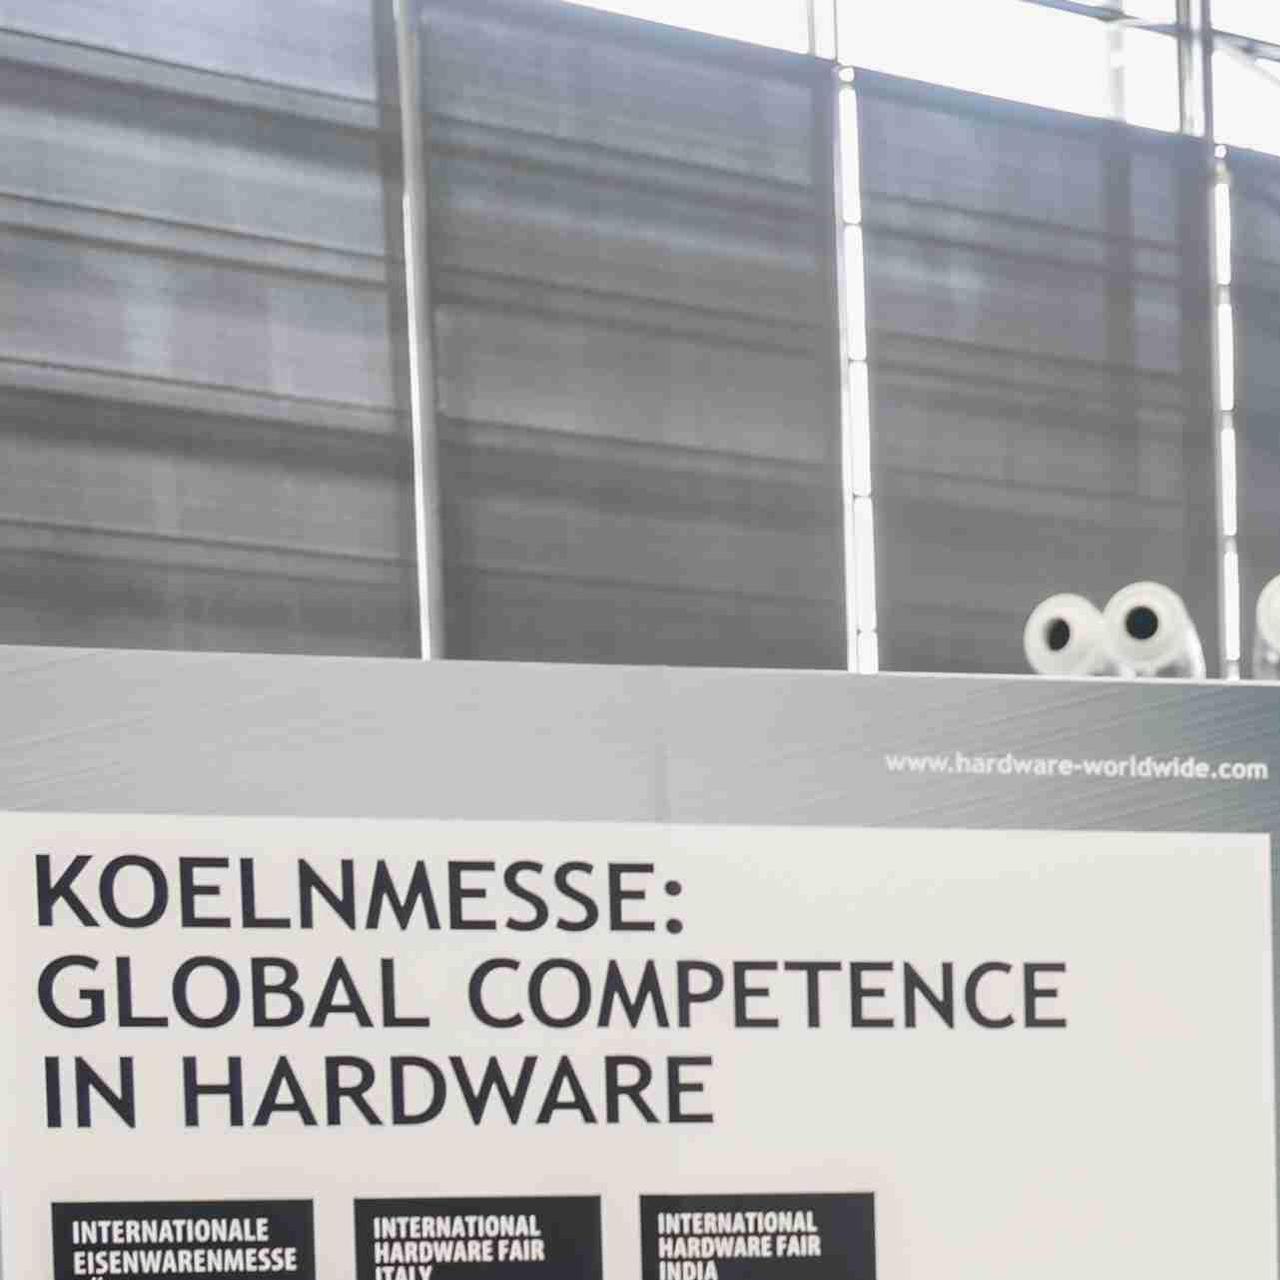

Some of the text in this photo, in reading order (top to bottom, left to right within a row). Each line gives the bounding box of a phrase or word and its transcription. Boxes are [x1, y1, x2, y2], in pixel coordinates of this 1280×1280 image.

[884, 750, 1269, 782] www.hardware-worldwide.com
[34, 853, 687, 934] KOELNMESSE:
[36, 954, 1070, 1031] GLOBAL COMPETENCE
[43, 1053, 716, 1130] IN HARDWARE
[72, 1218, 270, 1245] INTERNATIONALE
[373, 1214, 542, 1240] INTERNATIONAL
[657, 1211, 818, 1236] INTERNATIONAL
[374, 1238, 546, 1264] HARDWARE FAIR
[658, 1235, 822, 1259] HARDWARE FAIR
[73, 1247, 298, 1276] EISENWARENMESSE
